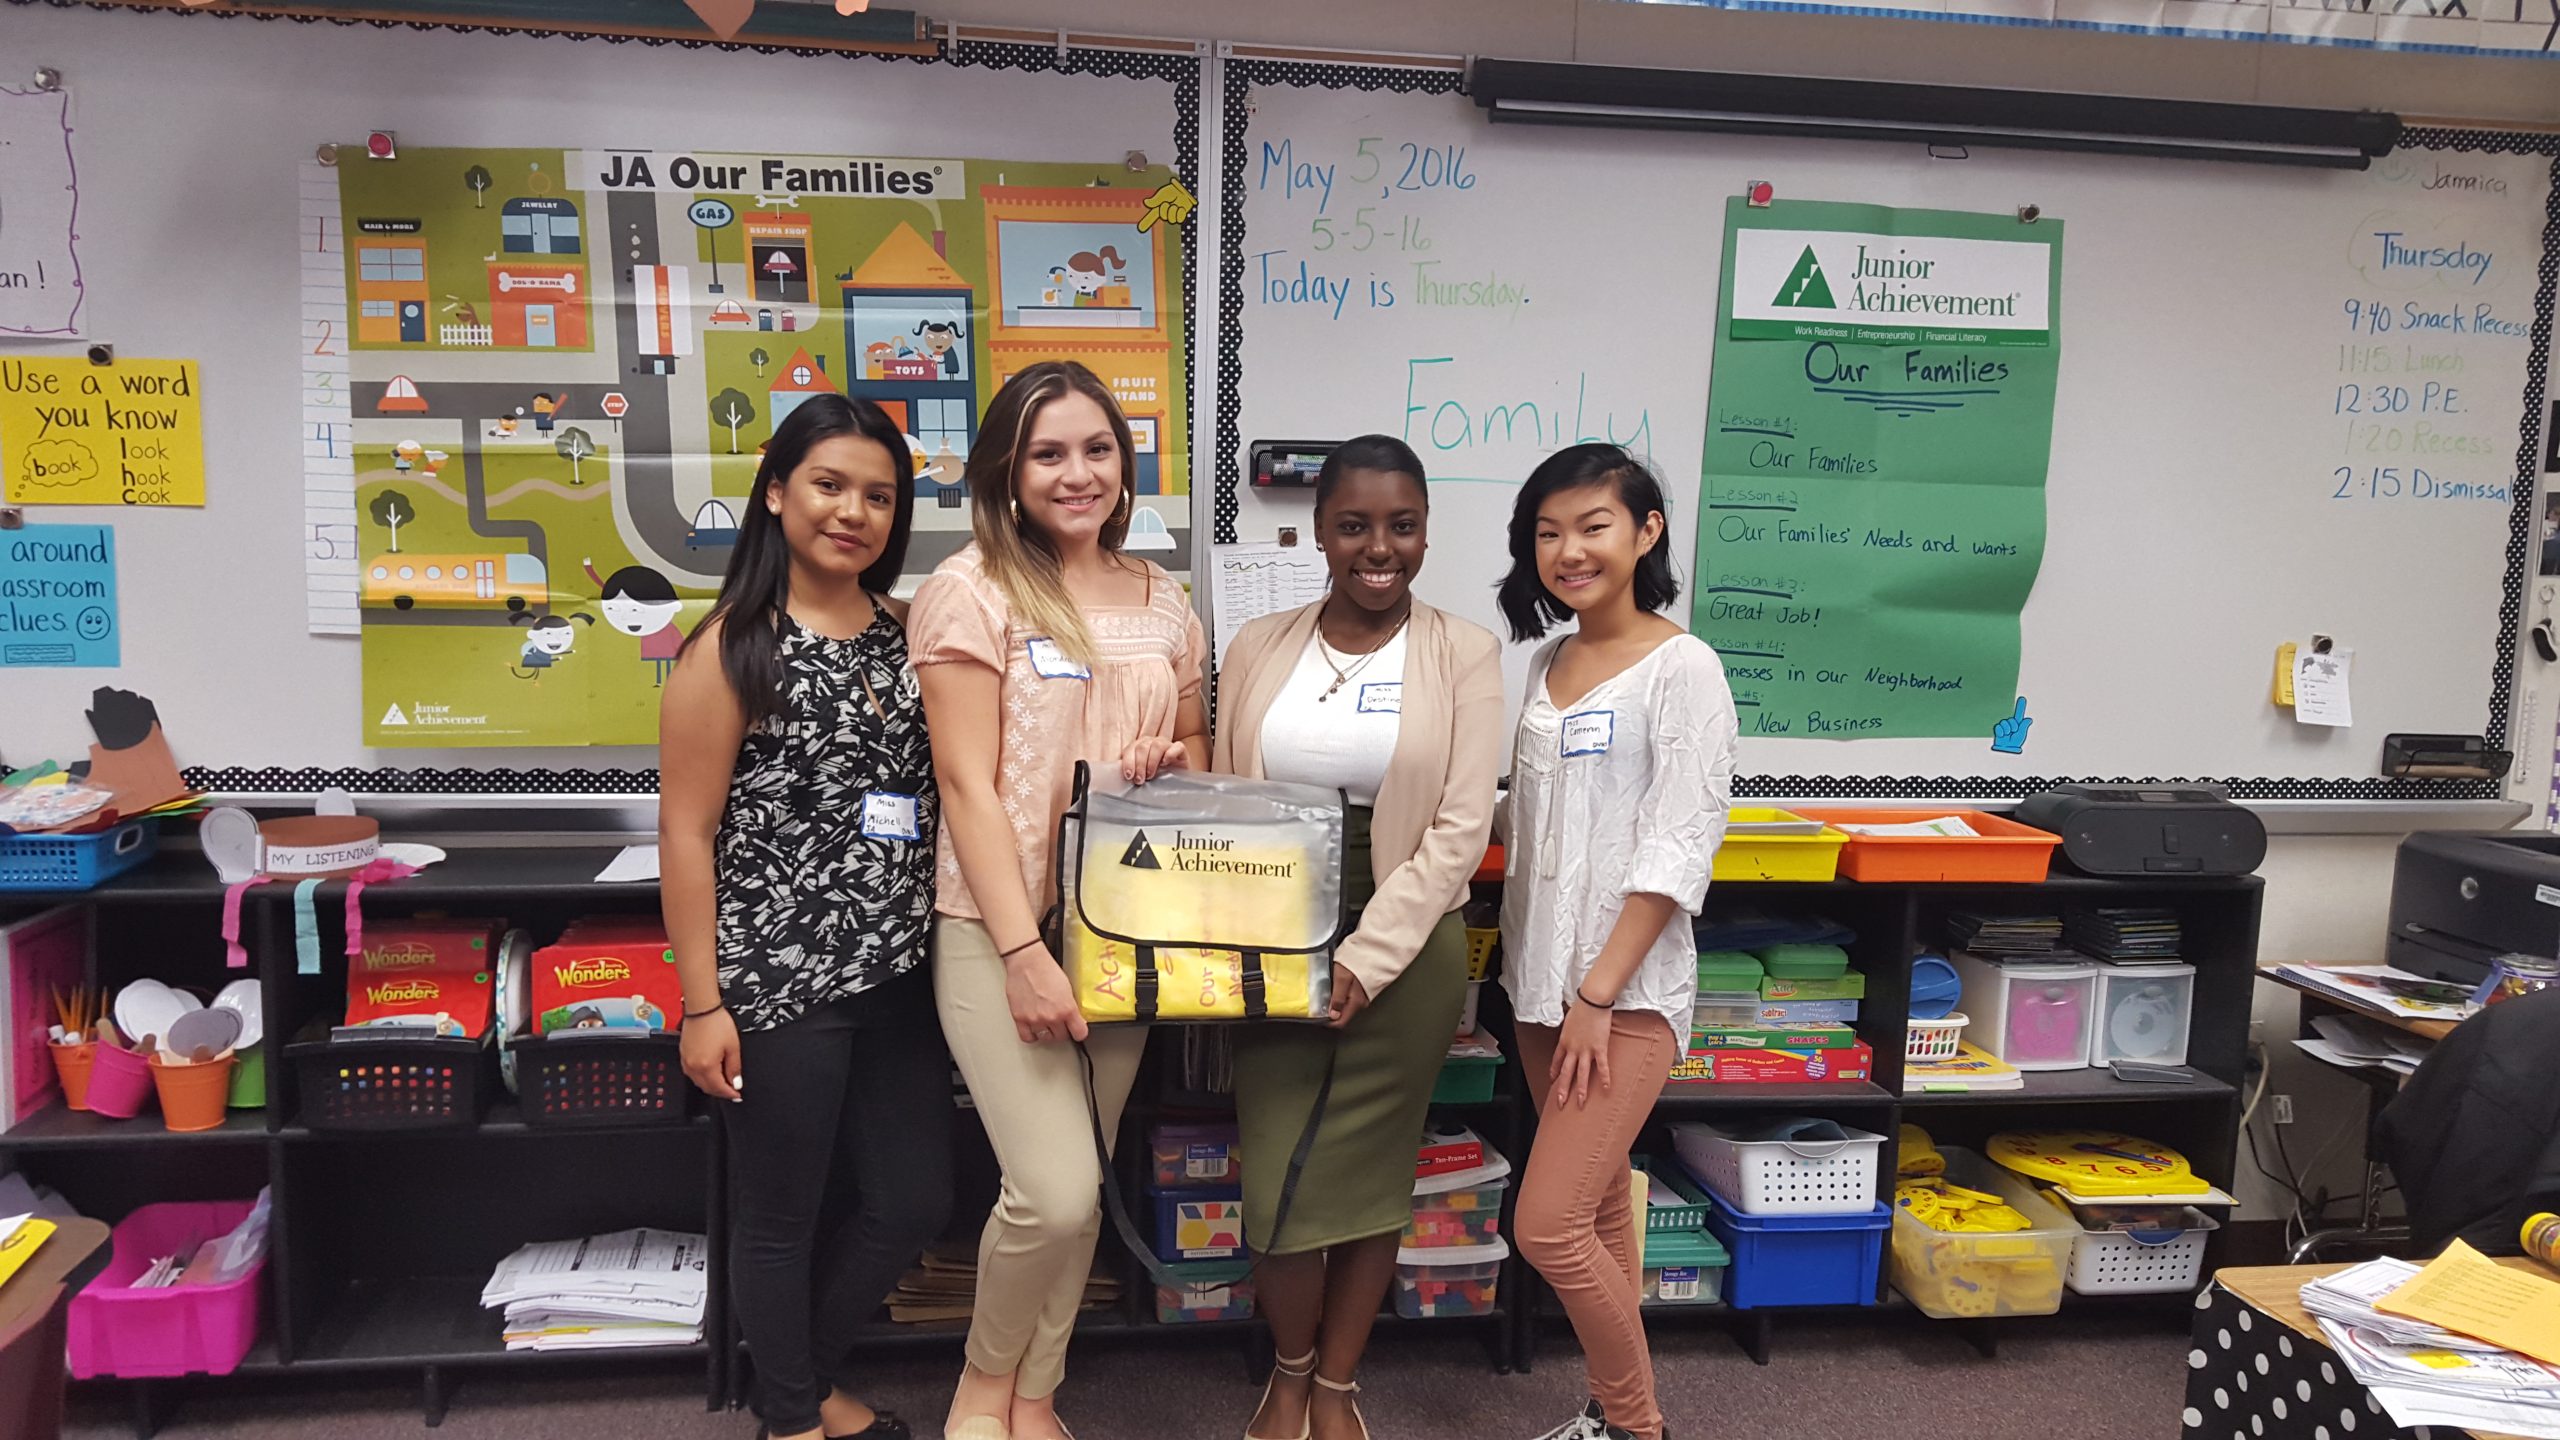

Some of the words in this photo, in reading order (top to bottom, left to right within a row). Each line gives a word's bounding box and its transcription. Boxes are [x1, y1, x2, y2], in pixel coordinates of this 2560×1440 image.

[601, 156, 654, 188] JA
[670, 157, 747, 192] Our
[1259, 138, 1335, 214] May
[2421, 162, 2507, 195] Jamaica
[696, 208, 726, 219] GAS
[749, 226, 783, 235] REPAIR
[785, 228, 808, 236] SHOP
[1311, 207, 1432, 252] 5-5-16
[1851, 245, 1935, 280] Junior
[2374, 232, 2493, 285] Thursday
[1251, 250, 1350, 320] Today
[1370, 272, 1395, 307] is
[2345, 298, 2391, 335] 9:40
[2400, 301, 2466, 333] Snack
[2473, 303, 2529, 337] Recess
[1795, 326, 1813, 336] Work
[1814, 327, 1848, 338] Readiness
[1857, 329, 1916, 341] Entrepreneurship
[1926, 332, 1958, 341] Financial
[1958, 333, 1988, 343] Literacy
[894, 364, 925, 377] TOYS
[1805, 341, 1869, 384] Our
[1905, 350, 2009, 383] Families
[2, 360, 60, 394] Use
[81, 375, 102, 395] a
[120, 365, 190, 397] word
[1113, 377, 1156, 388] FRUIT
[1114, 391, 1157, 401] STAND
[2335, 384, 2409, 414] 12:30
[2423, 381, 2469, 413] P.E.
[35, 406, 89, 439] you
[105, 400, 178, 430] know
[1720, 408, 1769, 427] Lesson
[120, 437, 169, 460] look
[1749, 441, 1795, 469] Our
[1809, 446, 1879, 474] Families
[33, 454, 82, 477] book
[121, 463, 171, 486] hook
[1710, 480, 1772, 504] Lesson
[2332, 466, 2401, 499] 2:15
[2413, 468, 2513, 504] Dismissal
[11, 530, 108, 563] around
[1718, 515, 1766, 543] Our
[1778, 519, 1851, 544] Families'
[1863, 529, 1913, 549] Needs
[1923, 535, 1959, 553] and
[1973, 540, 2017, 557] wants
[1706, 559, 1768, 589] Lesson
[1710, 596, 1764, 622] Great
[1776, 607, 1821, 628] Job!
[1789, 664, 1805, 682] in
[1817, 671, 1850, 684] our
[1864, 667, 1963, 692] Neighborhood
[414, 702, 450, 714] Junior
[415, 714, 487, 725] Achievement
[1754, 712, 1791, 733] New
[1807, 711, 1883, 732] Business
[877, 799, 896, 808] Miss
[1172, 831, 1234, 852] Junior
[272, 853, 295, 865] MY
[306, 845, 374, 866] LISTENING
[1170, 853, 1293, 878] Achievement
[363, 943, 436, 971] Wonders
[554, 960, 631, 988] Wonders
[366, 982, 440, 1006] Wonders
[1771, 984, 1794, 993] Add
[1787, 1036, 1830, 1045] SHAPES
[1813, 1055, 1823, 1063] 50
[1669, 1068, 1711, 1077] MONEY
[2080, 1164, 2099, 1173] 7
